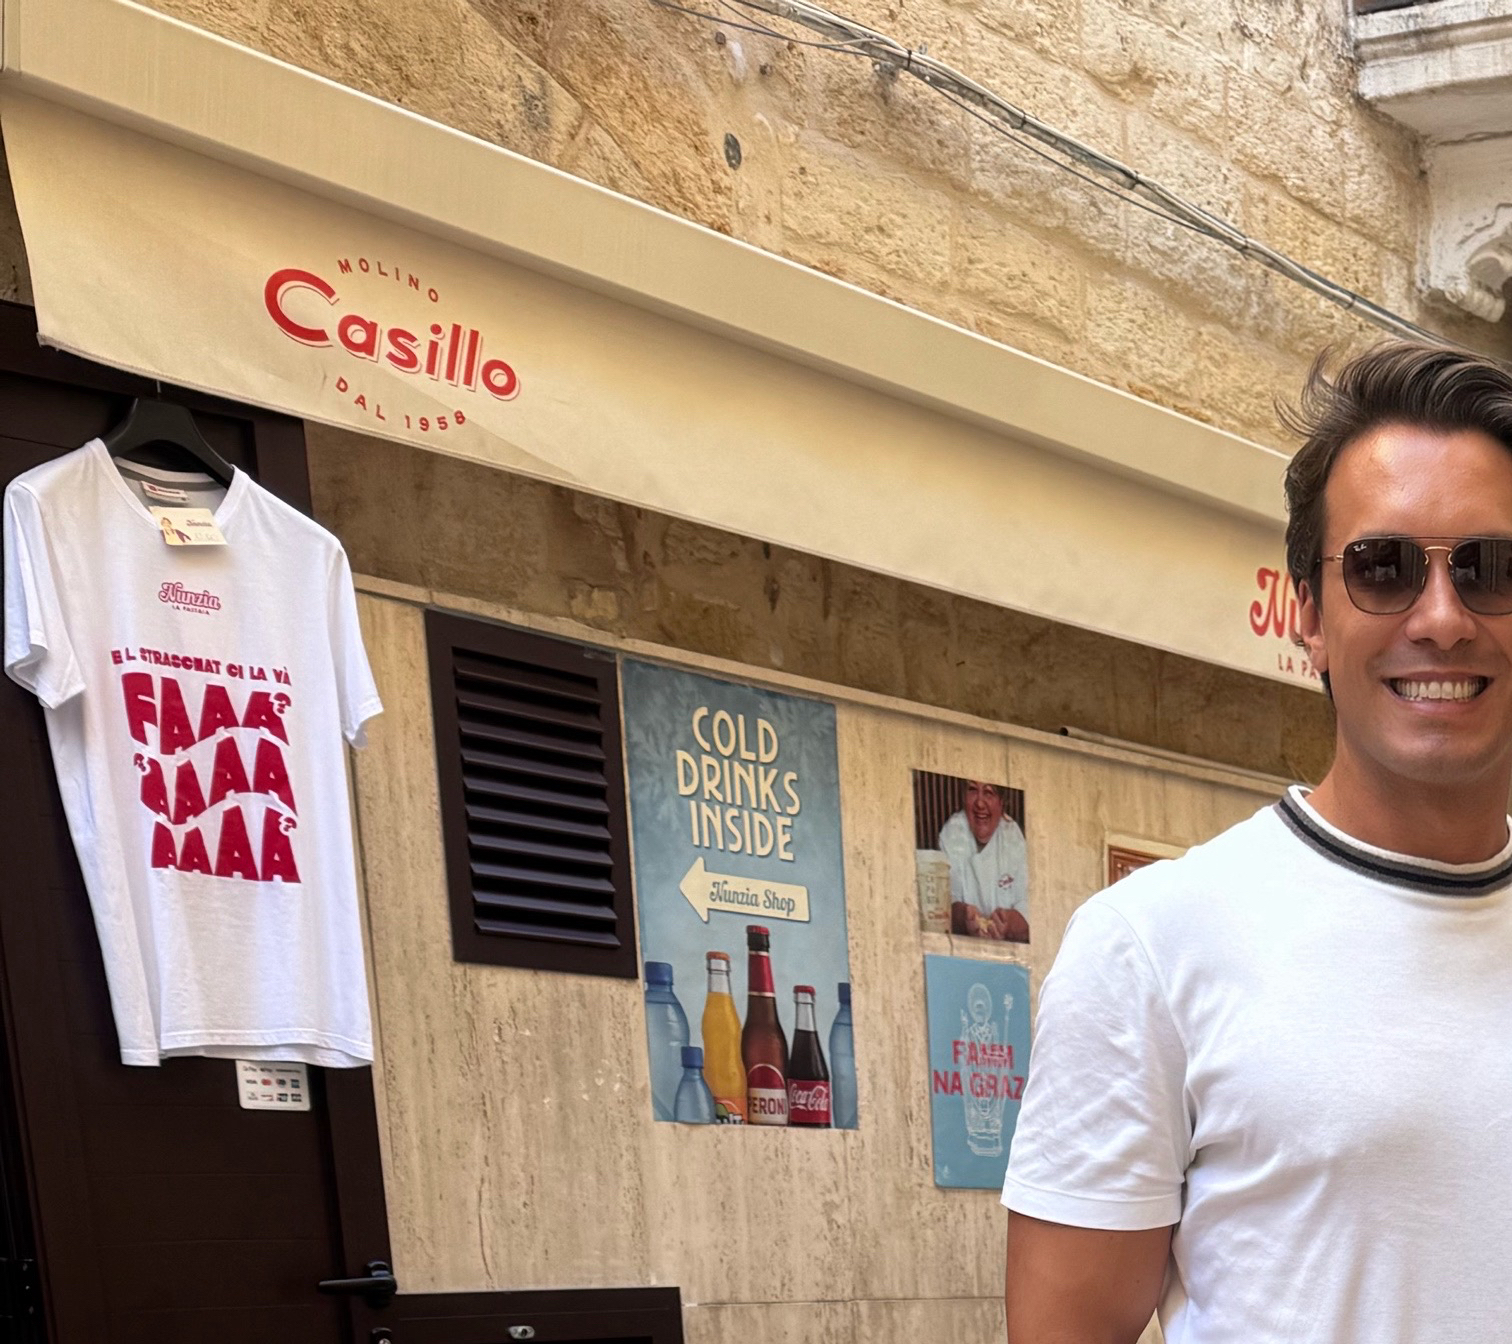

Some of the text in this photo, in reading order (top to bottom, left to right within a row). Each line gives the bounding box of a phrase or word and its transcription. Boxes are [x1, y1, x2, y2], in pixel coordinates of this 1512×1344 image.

[337, 257, 440, 303] MOLINO
[264, 268, 520, 401] Casillo
[335, 376, 466, 432] DAL 1958
[158, 581, 221, 610] Nunzia
[249, 665, 268, 681] LA
[1278, 653, 1318, 680] LA PA
[692, 706, 779, 764] COLD
[676, 749, 801, 815] DRINKS
[690, 800, 795, 861] INSIDE
[709, 880, 796, 917] Nunzia Shop
[933, 1069, 1025, 1101] NA GRAZ
